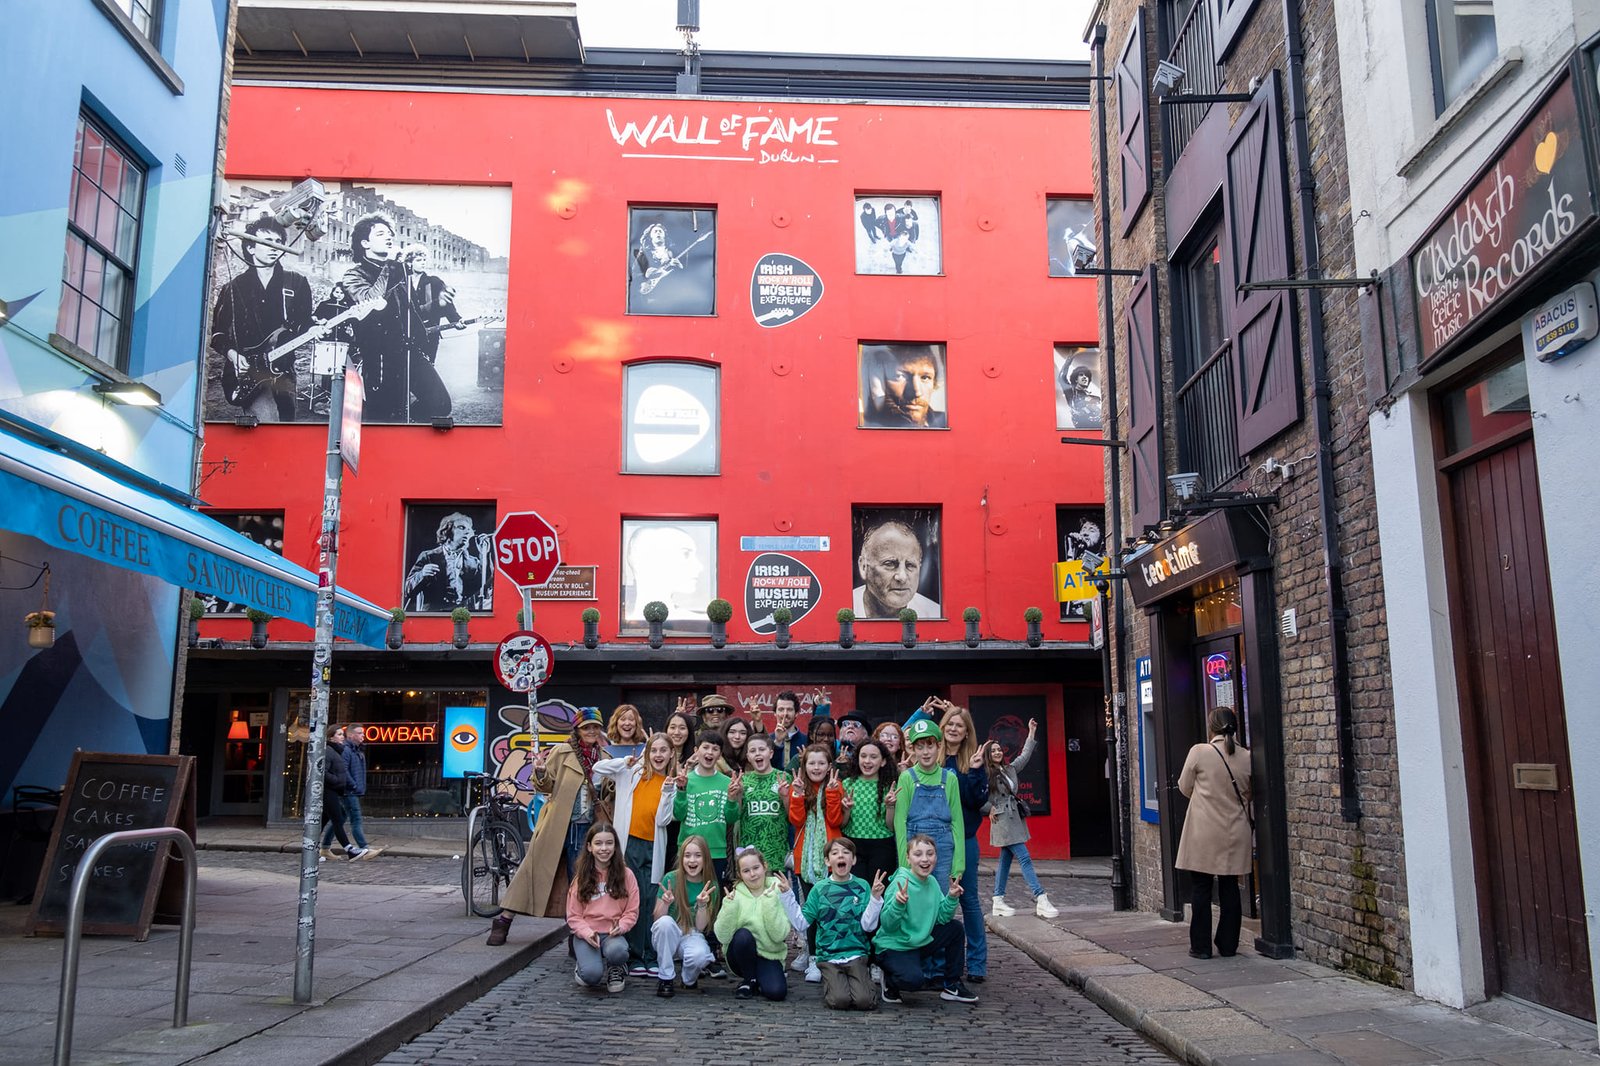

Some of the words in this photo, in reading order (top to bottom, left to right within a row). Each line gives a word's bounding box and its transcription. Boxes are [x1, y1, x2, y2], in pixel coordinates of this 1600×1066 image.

[606, 108, 722, 148] WALL
[720, 115, 743, 136] OF
[742, 116, 839, 151] FAME
[759, 148, 815, 164] DUBLIN
[1416, 162, 1515, 297] Claddagh
[1462, 176, 1576, 320] Records
[760, 264, 793, 275] IRISH
[760, 285, 811, 296] MUSEUM
[760, 296, 811, 305] EXPERIENCE
[1432, 292, 1461, 328] Celtic
[1535, 298, 1575, 332] ABACUS
[1538, 339, 1545, 347] 01
[1558, 320, 1575, 336] 5116
[58, 504, 152, 567] COFFEE
[499, 536, 556, 564] STOP
[1503, 554, 1510, 570] 2
[755, 565, 789, 576] IRISH
[187, 552, 292, 614] SANDWICHES
[754, 588, 809, 599] MUSEUM
[754, 599, 809, 609] EXPERIENCE
[737, 692, 779, 708] WAL
[365, 726, 434, 742] OWBAR
[917, 723, 924, 731] L
[81, 778, 165, 802] COFFEE
[750, 801, 780, 812] BDO
[73, 807, 135, 826] CAKES
[60, 864, 125, 881] SKES
